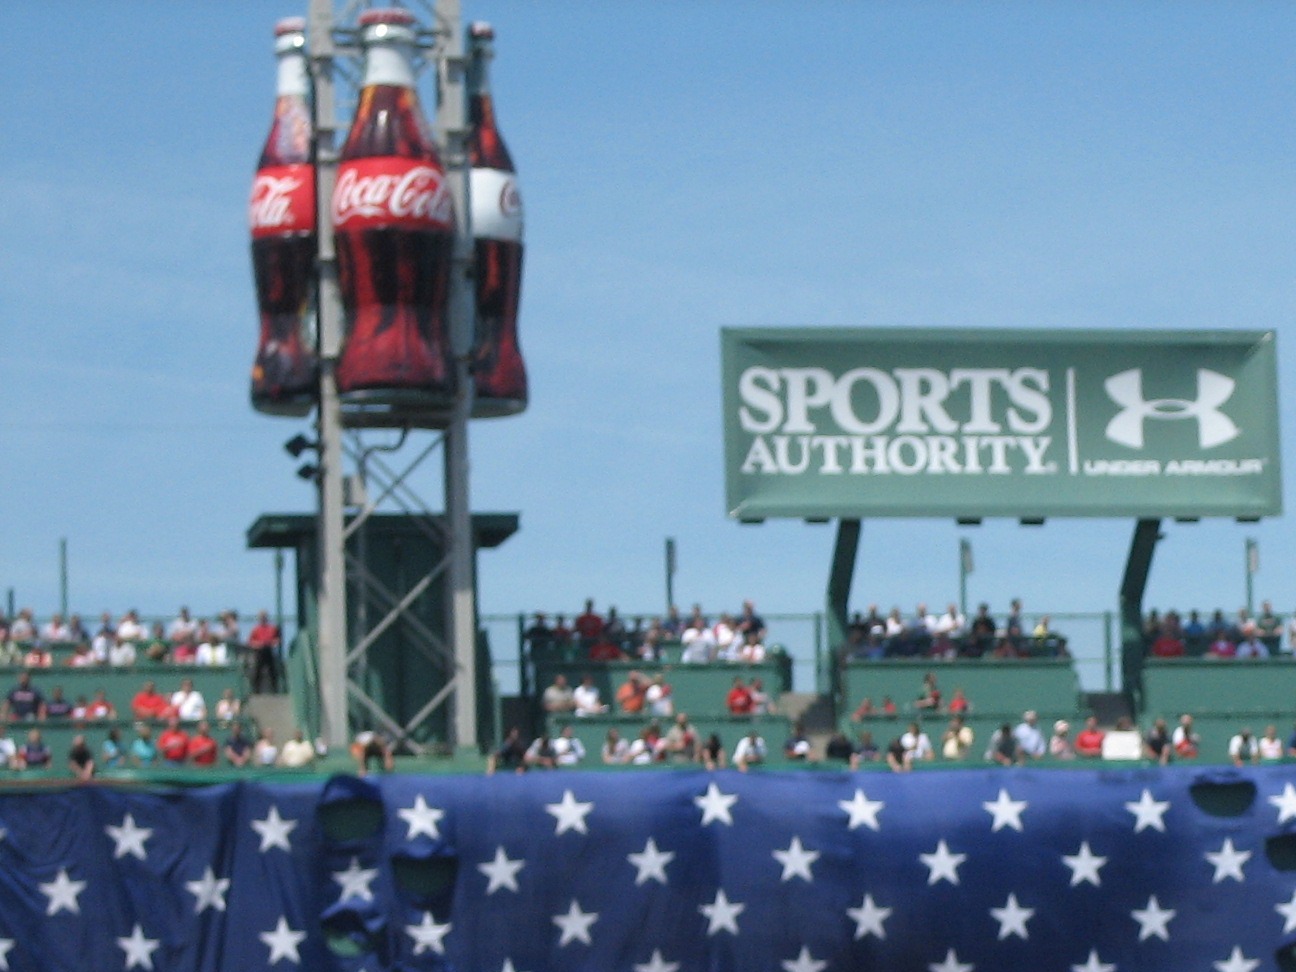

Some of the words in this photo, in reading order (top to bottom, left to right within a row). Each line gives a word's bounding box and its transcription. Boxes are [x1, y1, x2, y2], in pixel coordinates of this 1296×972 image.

[739, 366, 1053, 435] SPORTS
[741, 434, 1051, 475] AUTHORITY
[1083, 458, 1162, 477] UNDER
[1163, 457, 1264, 476] ARMOUR
